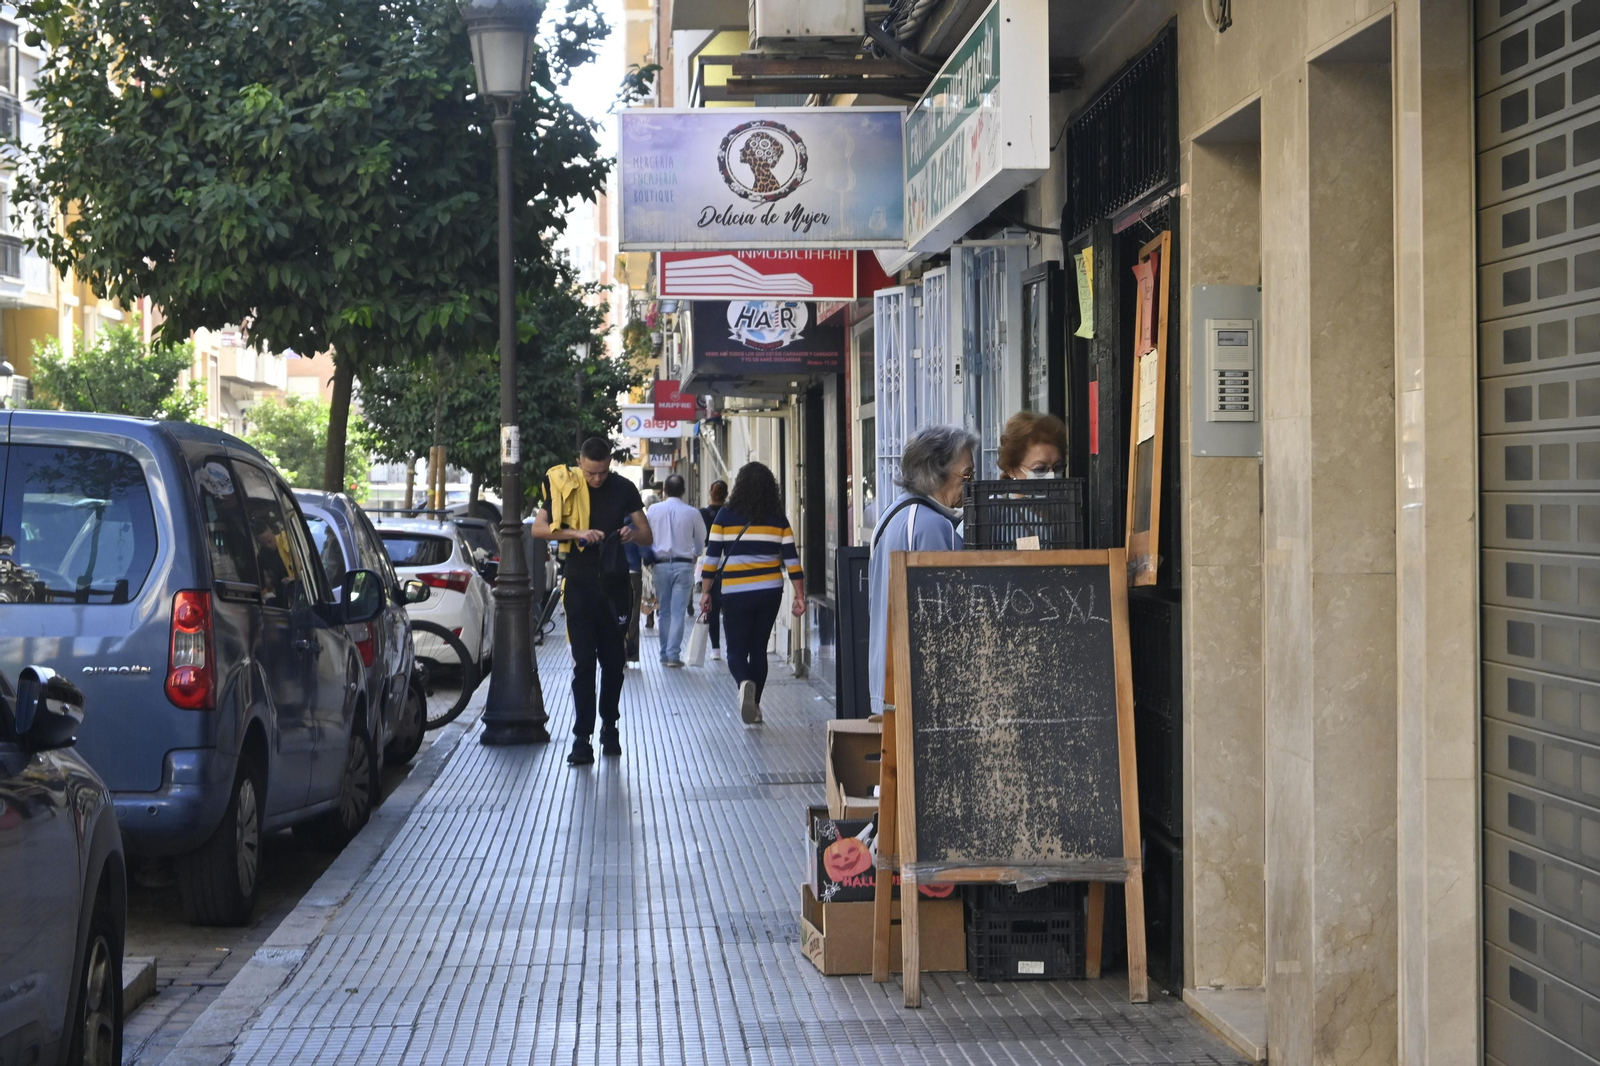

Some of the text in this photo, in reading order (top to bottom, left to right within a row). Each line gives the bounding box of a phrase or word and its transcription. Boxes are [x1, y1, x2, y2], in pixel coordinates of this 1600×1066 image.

[931, 127, 967, 220] RAFAEL
[633, 189, 675, 203] BOUTIQUE
[697, 203, 830, 233] Delicia de Mujer
[737, 249, 849, 260] INMOBILIARIA
[643, 418, 678, 432] alejo
[651, 454, 671, 462] ATM
[82, 665, 151, 676] CITROËN
